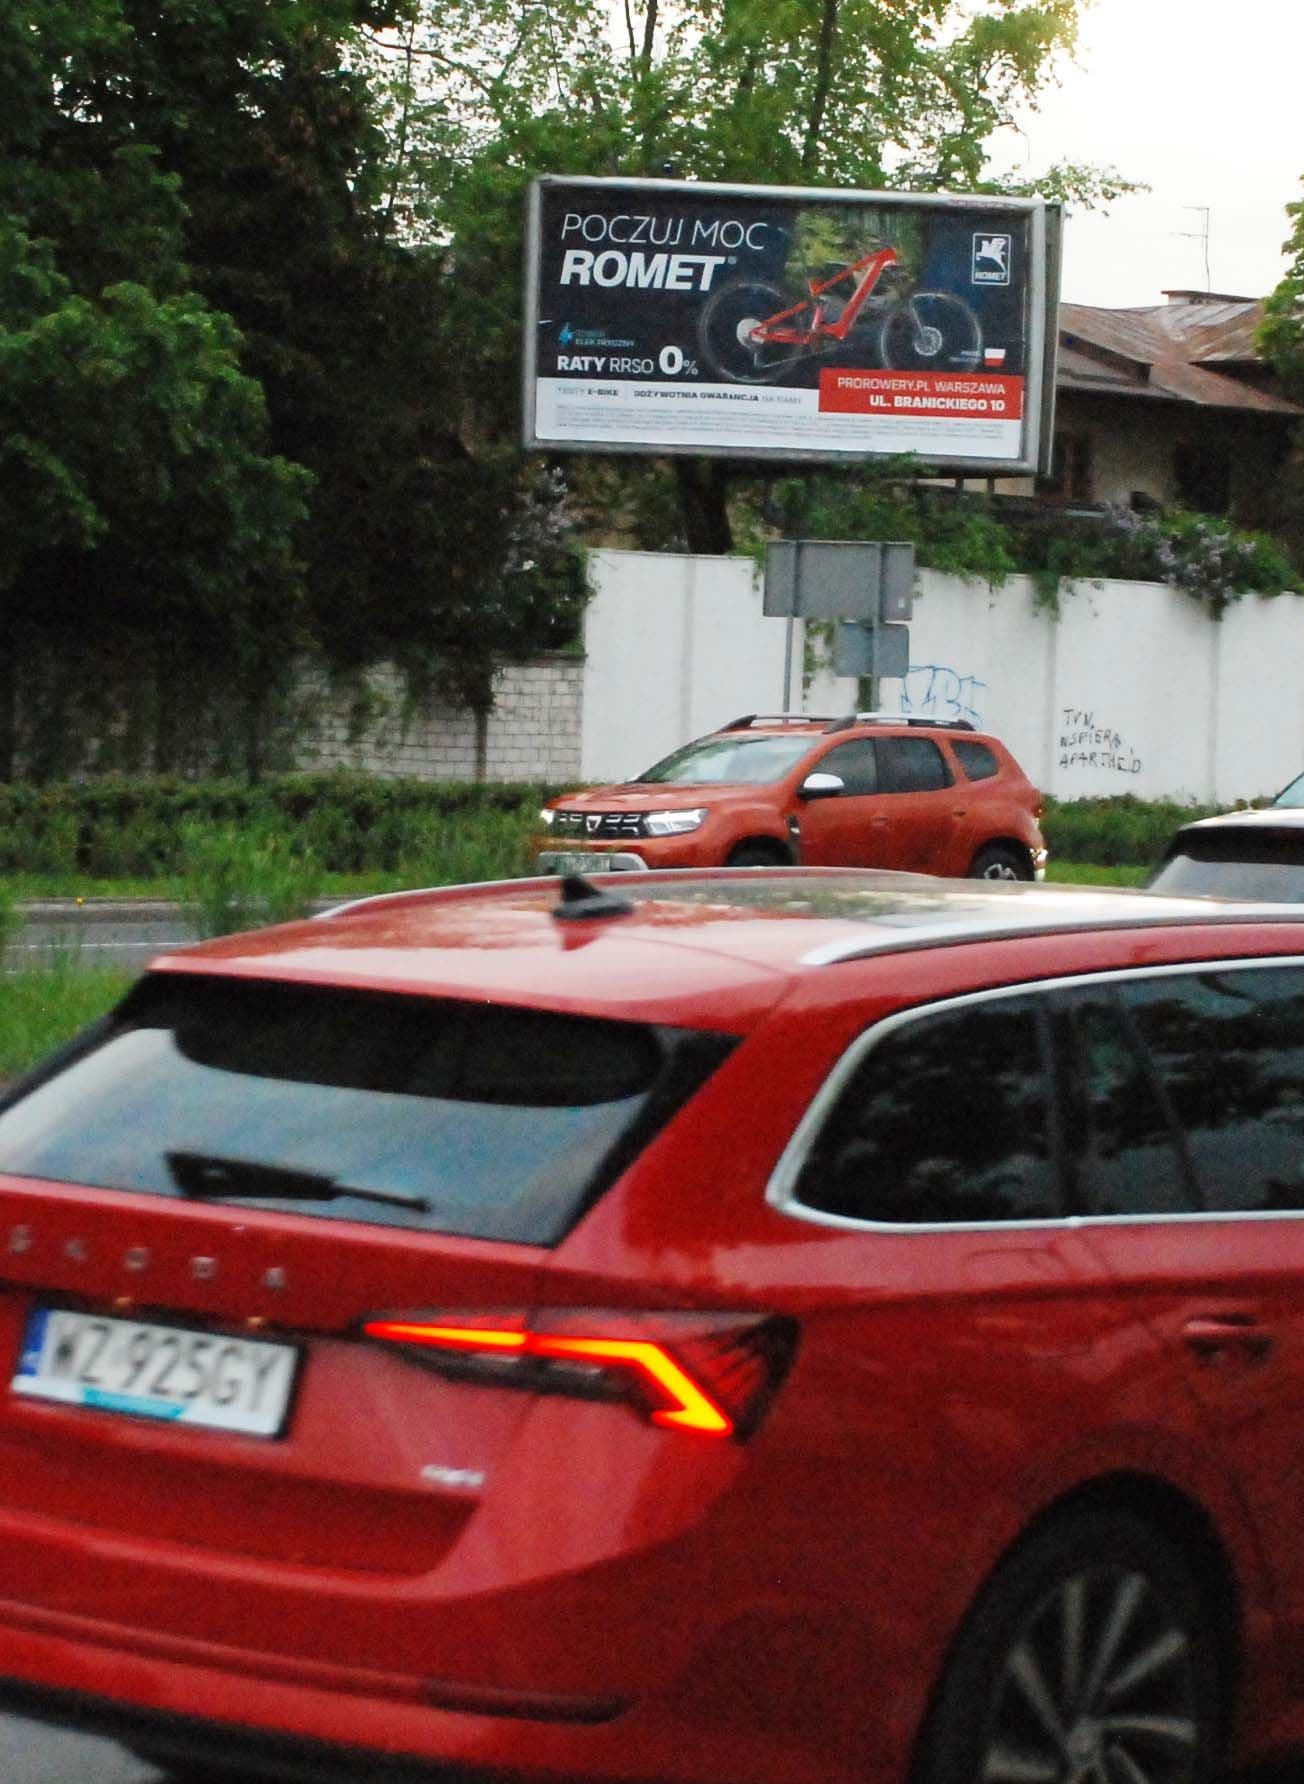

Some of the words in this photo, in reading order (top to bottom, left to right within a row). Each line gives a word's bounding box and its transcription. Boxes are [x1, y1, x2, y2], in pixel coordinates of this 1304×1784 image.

[561, 213, 683, 245] POCZUJ
[691, 219, 769, 250] MOC
[559, 249, 726, 292] ROMET
[556, 355, 606, 371] RATY
[609, 357, 654, 374] RRSO
[837, 376, 930, 392] PROROWERY.PL
[934, 381, 1006, 395] WARSZAWA
[893, 396, 985, 411] BRANICKIEGO
[989, 399, 1006, 411] 10
